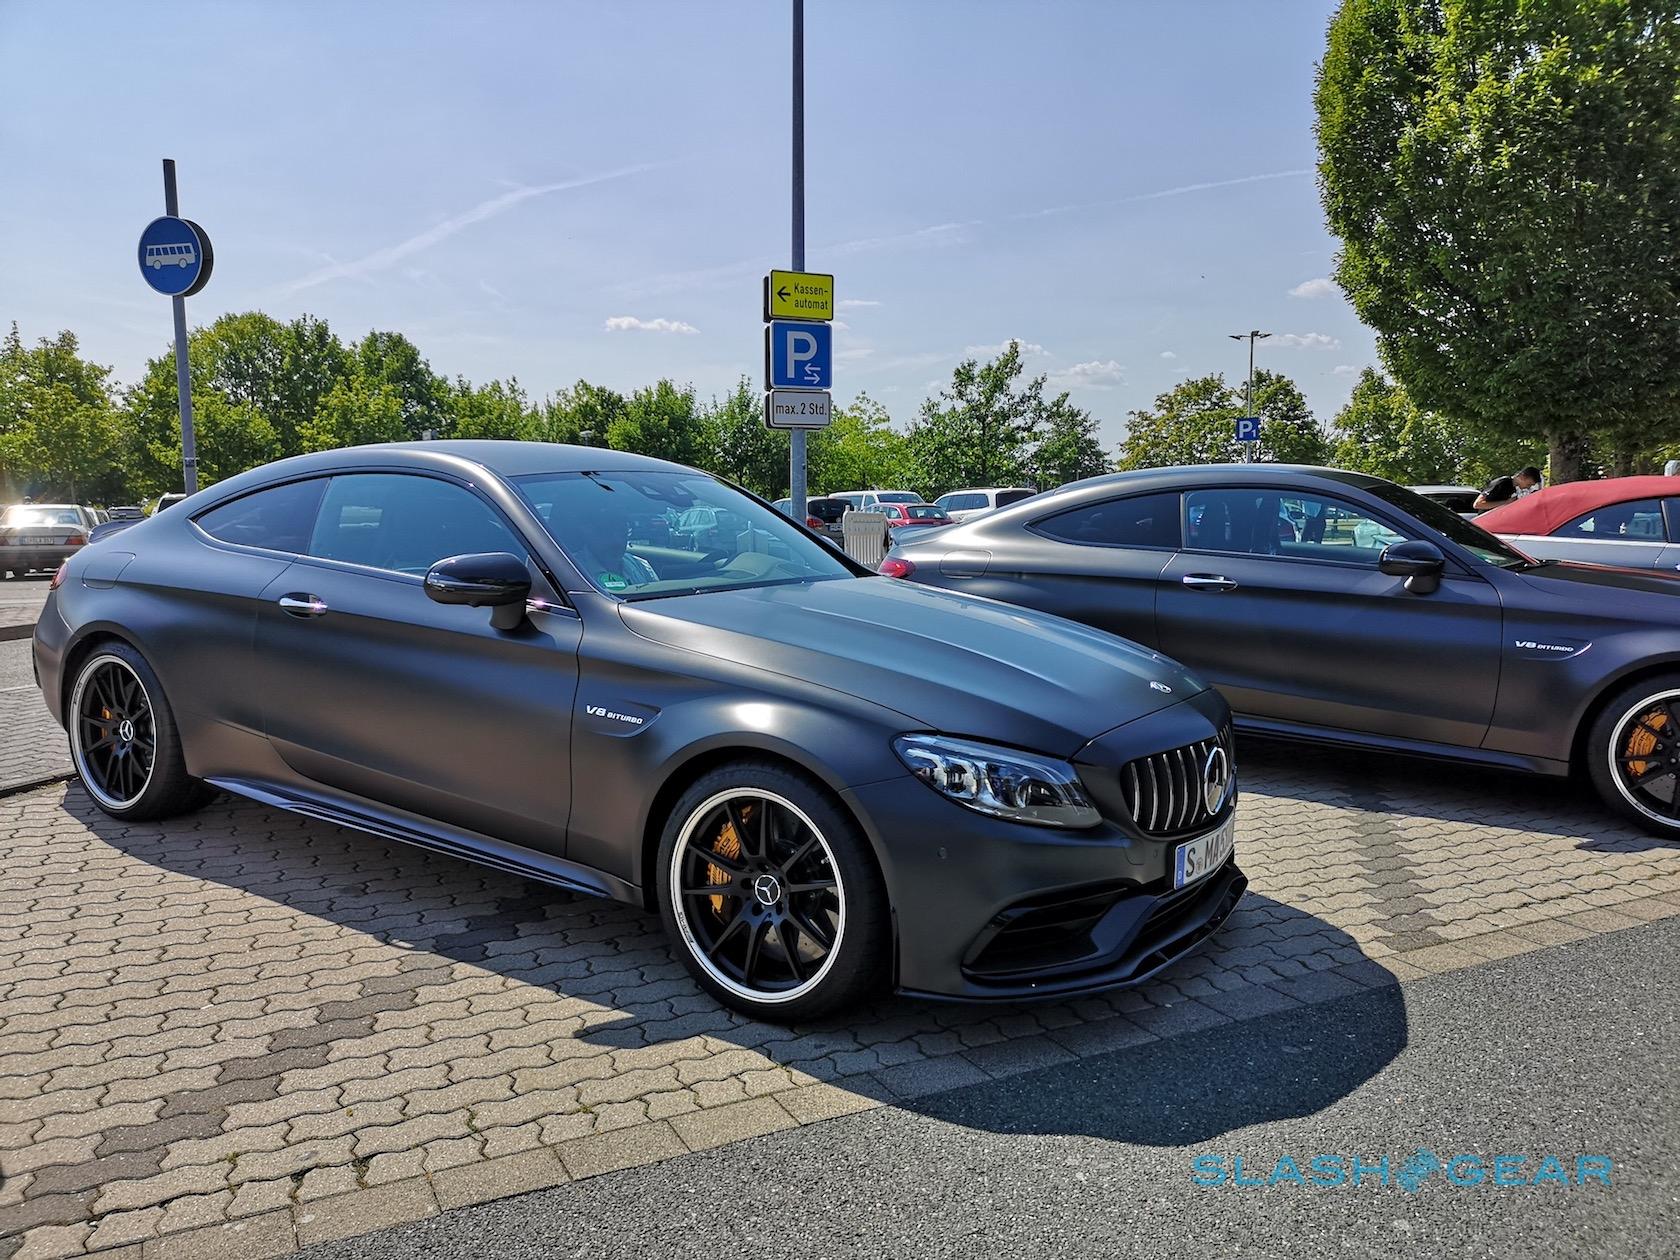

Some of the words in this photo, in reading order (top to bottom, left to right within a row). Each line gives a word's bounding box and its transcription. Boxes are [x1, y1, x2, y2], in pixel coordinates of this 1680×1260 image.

[794, 282, 828, 296] Kassen-
[794, 298, 828, 310] automat
[786, 330, 818, 379] P
[775, 403, 799, 415] max.
[800, 402, 806, 414] 2
[808, 402, 827, 416] Std.
[1515, 640, 1537, 649] V8
[1537, 644, 1574, 652] BITURBO
[586, 704, 607, 717] V8
[607, 712, 644, 724] BITURBO
